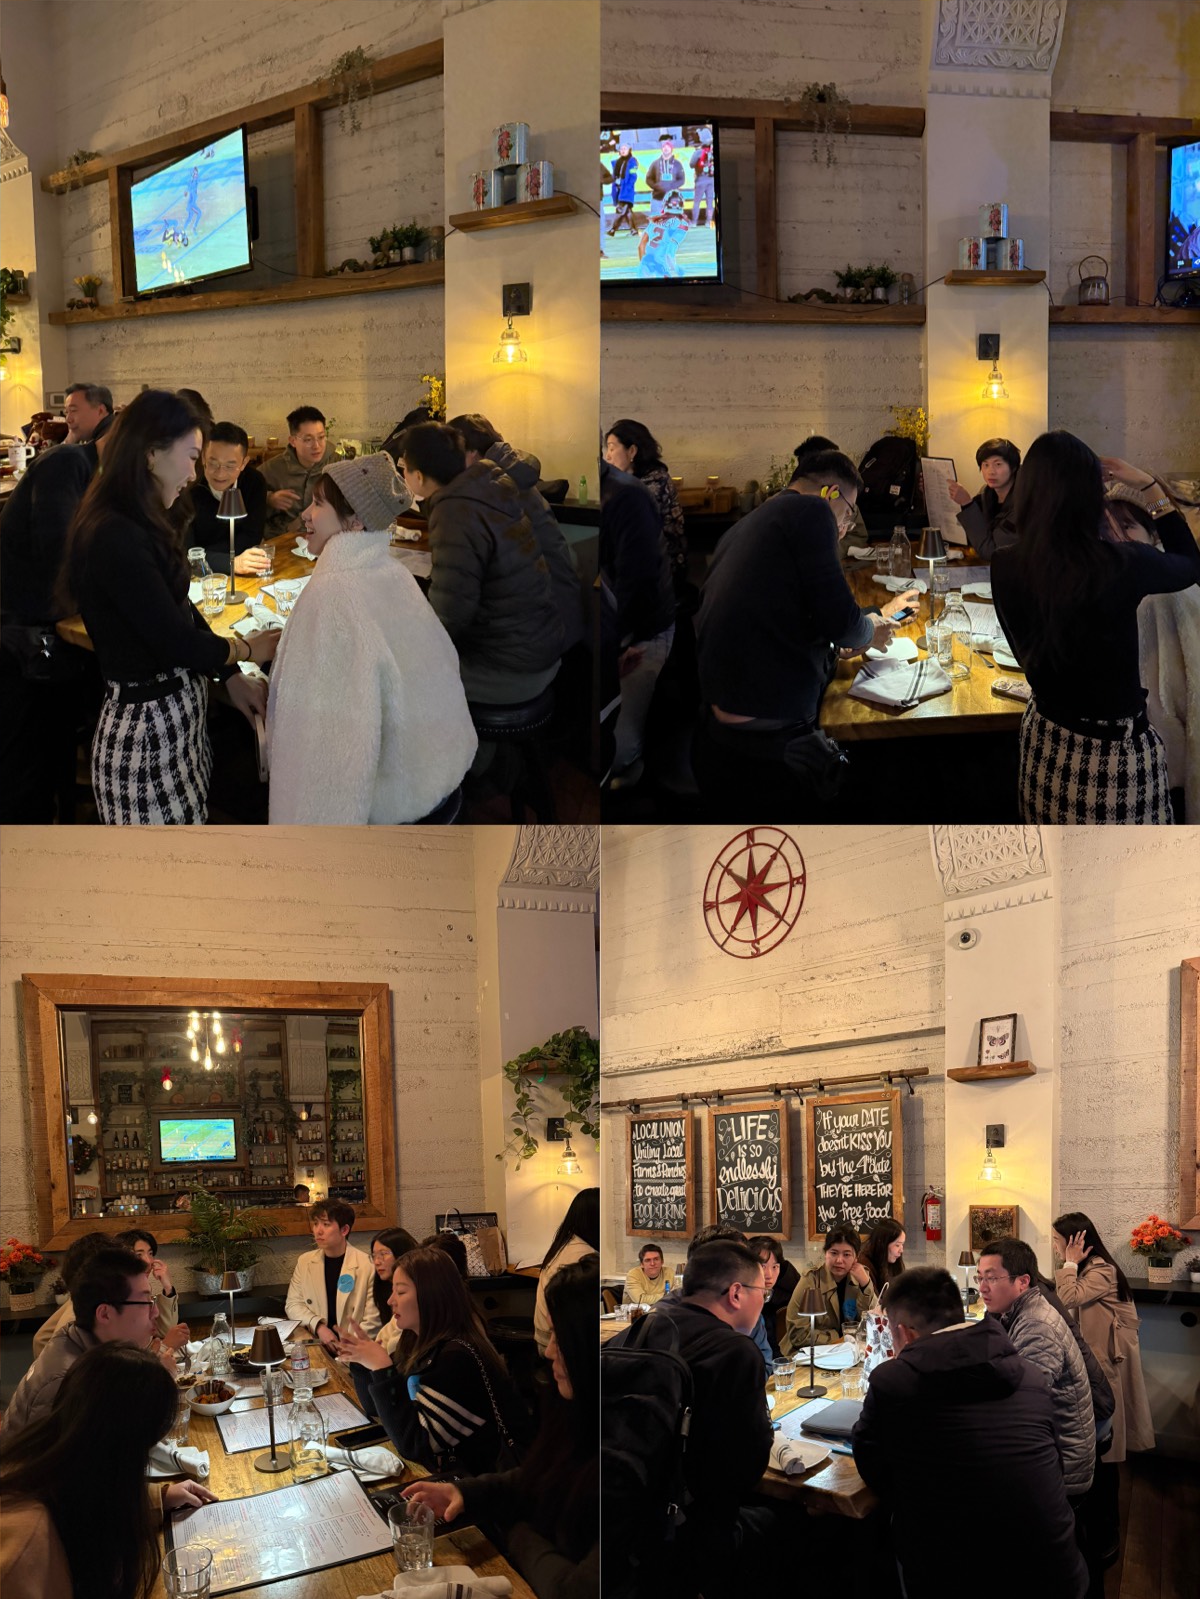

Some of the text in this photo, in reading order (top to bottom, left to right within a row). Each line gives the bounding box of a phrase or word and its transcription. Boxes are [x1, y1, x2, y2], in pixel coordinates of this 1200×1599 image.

[635, 1119, 685, 1140] LOCAL UNION
[730, 1114, 771, 1142] LIFE
[823, 1107, 889, 1134] If your DATE
[850, 1132, 873, 1151] KISS
[719, 1155, 778, 1189] endlessly
[820, 1159, 836, 1177] by
[837, 1157, 857, 1176] the
[869, 1157, 892, 1174] date
[634, 1183, 643, 1197] to
[818, 1201, 892, 1222] the free food
